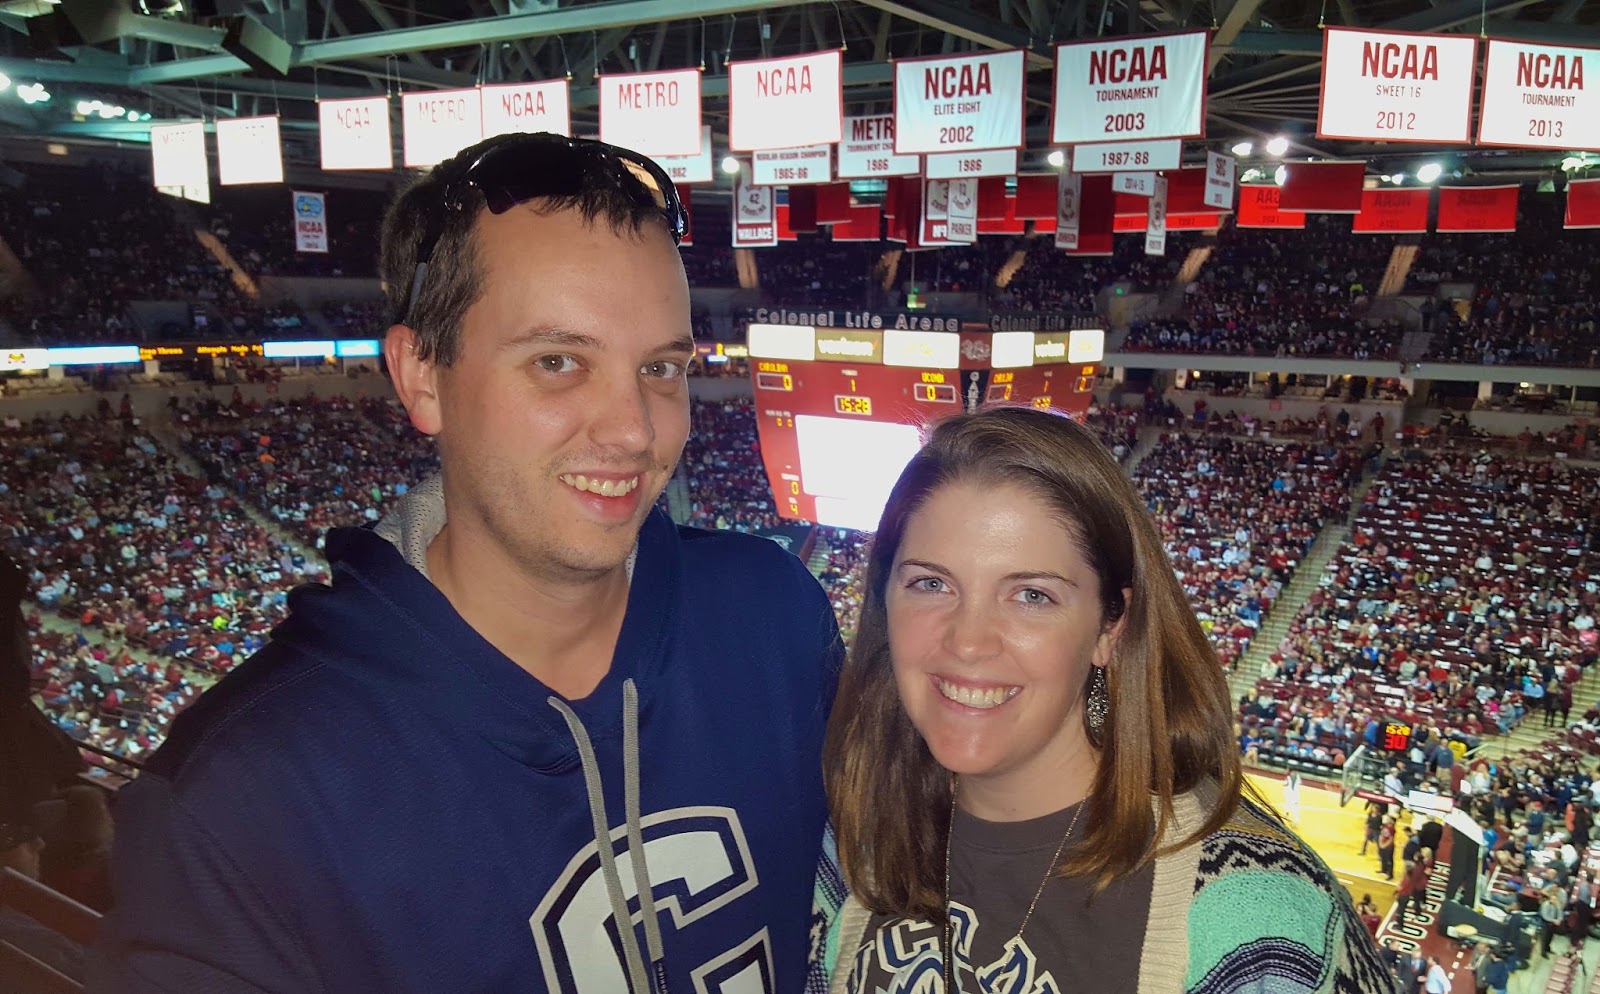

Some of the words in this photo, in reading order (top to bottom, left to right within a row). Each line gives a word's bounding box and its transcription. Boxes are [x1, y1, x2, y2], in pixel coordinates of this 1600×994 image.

[1089, 45, 1167, 85] NCAA
[1361, 41, 1438, 80] NCAA
[1516, 52, 1584, 90] NCAA
[757, 64, 812, 97] NCAA
[925, 62, 992, 100] NCAA
[618, 80, 679, 109] METRO
[1096, 86, 1160, 102] TOURNAMENT
[1376, 85, 1405, 97] SWEET
[1410, 87, 1421, 98] 16
[1522, 92, 1575, 107] TOURNAMENT
[418, 99, 465, 123] METRO
[502, 90, 546, 117] NCAA
[934, 104, 956, 115] ELITE
[957, 102, 981, 113] EIGHT
[1105, 113, 1145, 132] 2003
[1376, 111, 1416, 130] 2012
[1528, 119, 1563, 138] 2013
[852, 117, 893, 142] METR
[940, 125, 974, 144] 2002
[867, 159, 889, 171] 1986
[958, 159, 982, 172] 1986
[1102, 151, 1149, 166] 1987-88
[774, 168, 808, 180] 1985-86
[738, 228, 772, 240] WALLACE
[756, 308, 834, 327] Colonial
[845, 311, 882, 328] Life
[895, 313, 958, 332] Arena
[783, 375, 792, 391] 0
[851, 379, 856, 392] 1
[927, 385, 936, 401] 0
[841, 398, 871, 413] 15:28
[791, 481, 799, 495] 0
[790, 504, 799, 515] 4
[1384, 733, 1407, 750] 30
